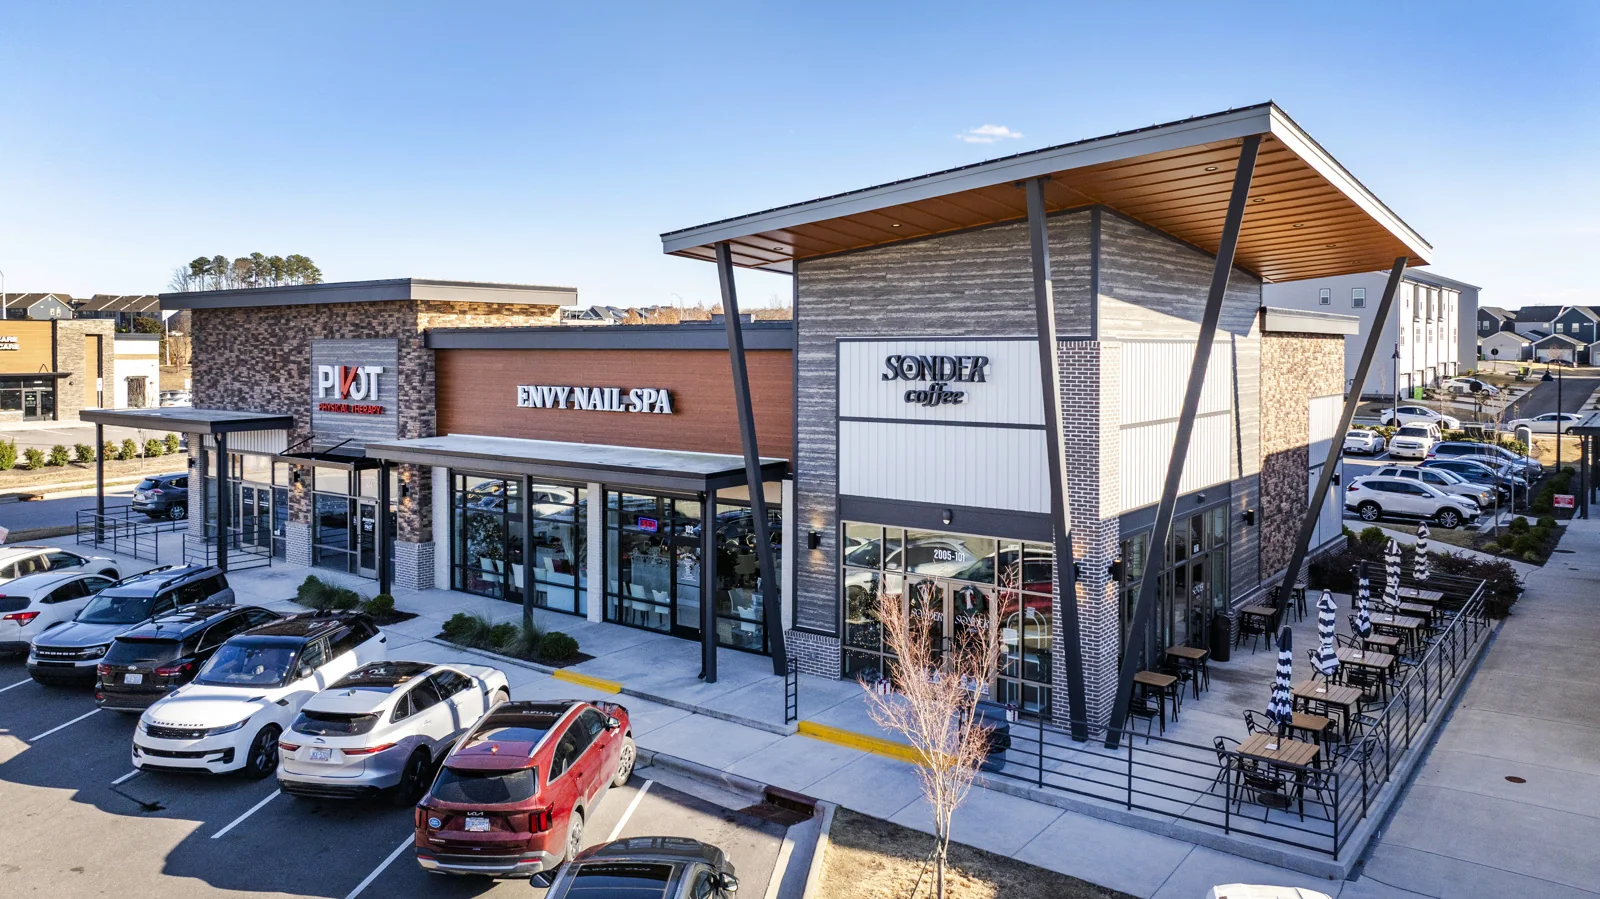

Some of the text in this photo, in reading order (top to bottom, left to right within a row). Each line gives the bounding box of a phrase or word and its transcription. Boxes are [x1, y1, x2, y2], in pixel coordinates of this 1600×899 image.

[881, 354, 990, 383] SONDER
[318, 364, 384, 401] PIVOT
[903, 382, 965, 408] coffee
[318, 402, 383, 415] PHYSICAL THERAPY
[516, 385, 673, 414] ENVY NAIL SPA
[933, 549, 966, 562] 2005-101
